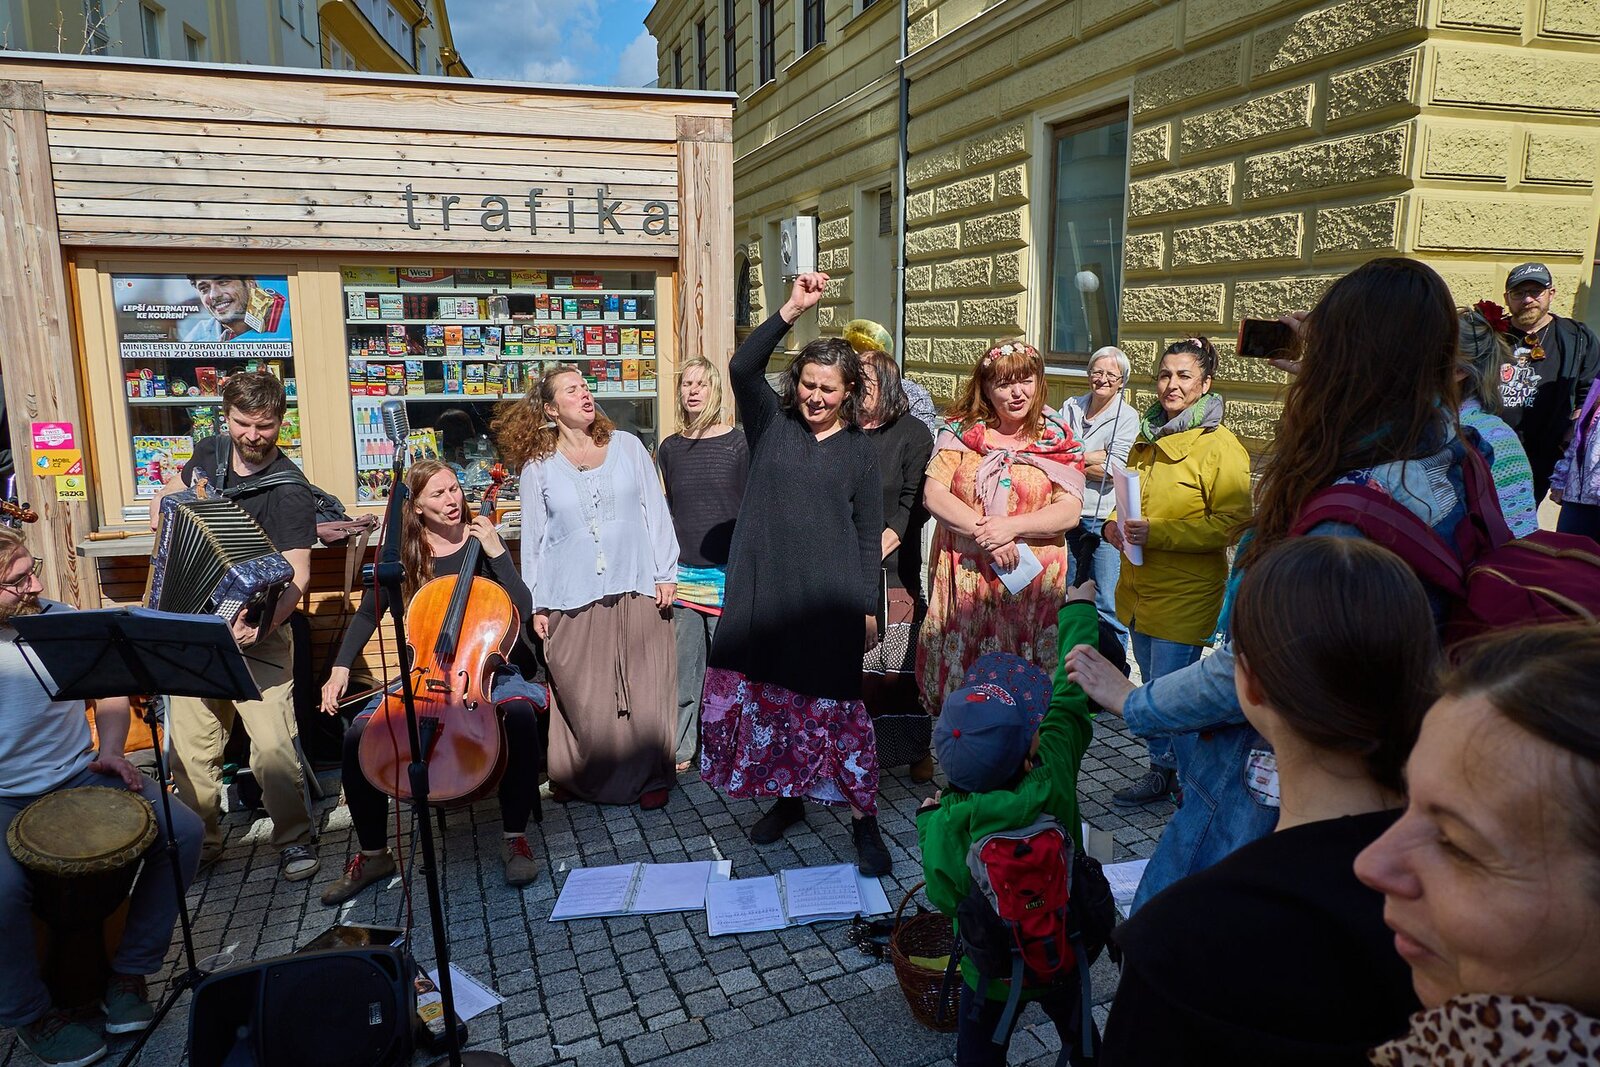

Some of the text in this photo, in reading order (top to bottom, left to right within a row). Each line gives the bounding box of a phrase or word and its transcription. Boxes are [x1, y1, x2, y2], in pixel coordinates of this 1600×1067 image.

[401, 184, 672, 236] trafika
[408, 267, 433, 277] West
[123, 303, 146, 312] LEPŠÍ
[122, 343, 186, 351] MINISTERSTVO
[256, 342, 290, 350] VARUJE:
[238, 350, 291, 358] RAKOVINU
